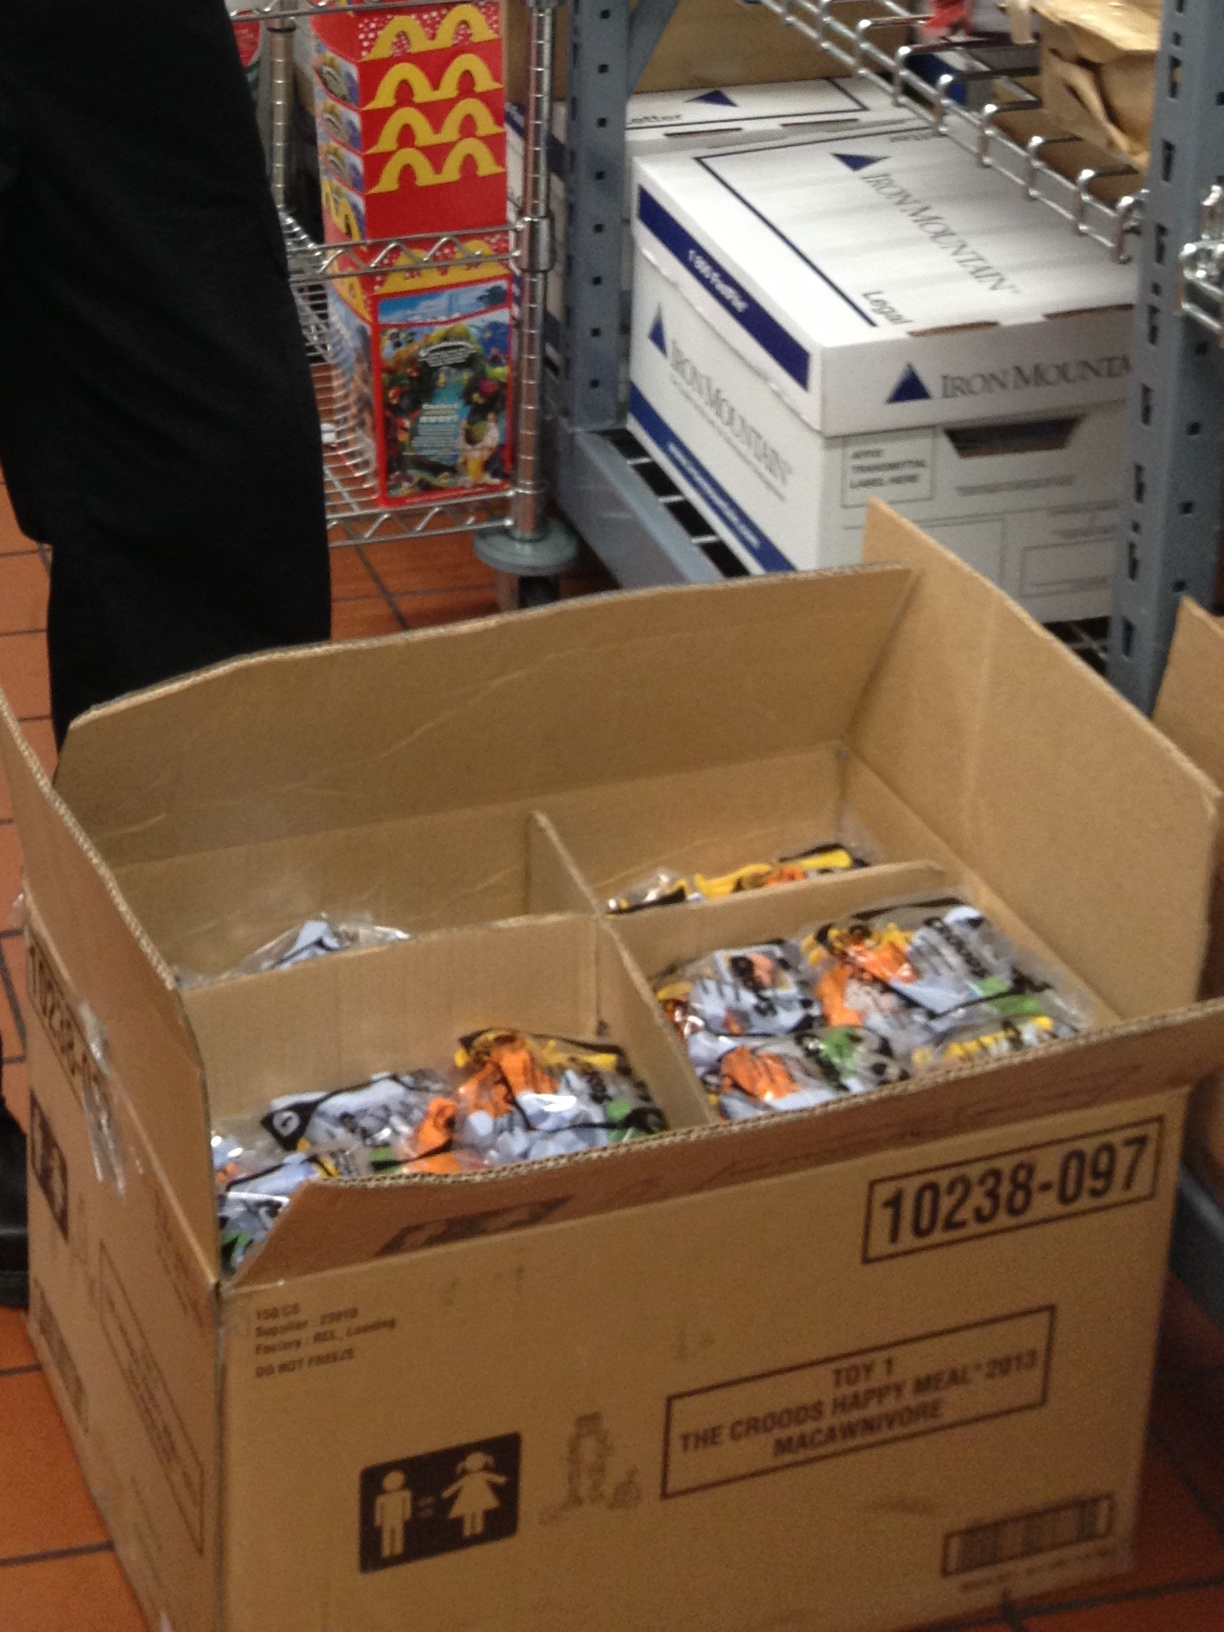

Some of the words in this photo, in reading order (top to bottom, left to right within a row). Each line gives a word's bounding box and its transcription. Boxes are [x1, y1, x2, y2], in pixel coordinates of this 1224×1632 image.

[863, 290, 913, 325] Legal
[882, 1133, 1149, 1244] 10238-097
[680, 1422, 722, 1454] THE
[727, 1398, 826, 1442] CROODS
[830, 1380, 905, 1417] HAPPY
[984, 1347, 1039, 1381] 2013
[832, 1363, 876, 1390] TOY
[773, 1398, 946, 1457] MACAWNIVORE
